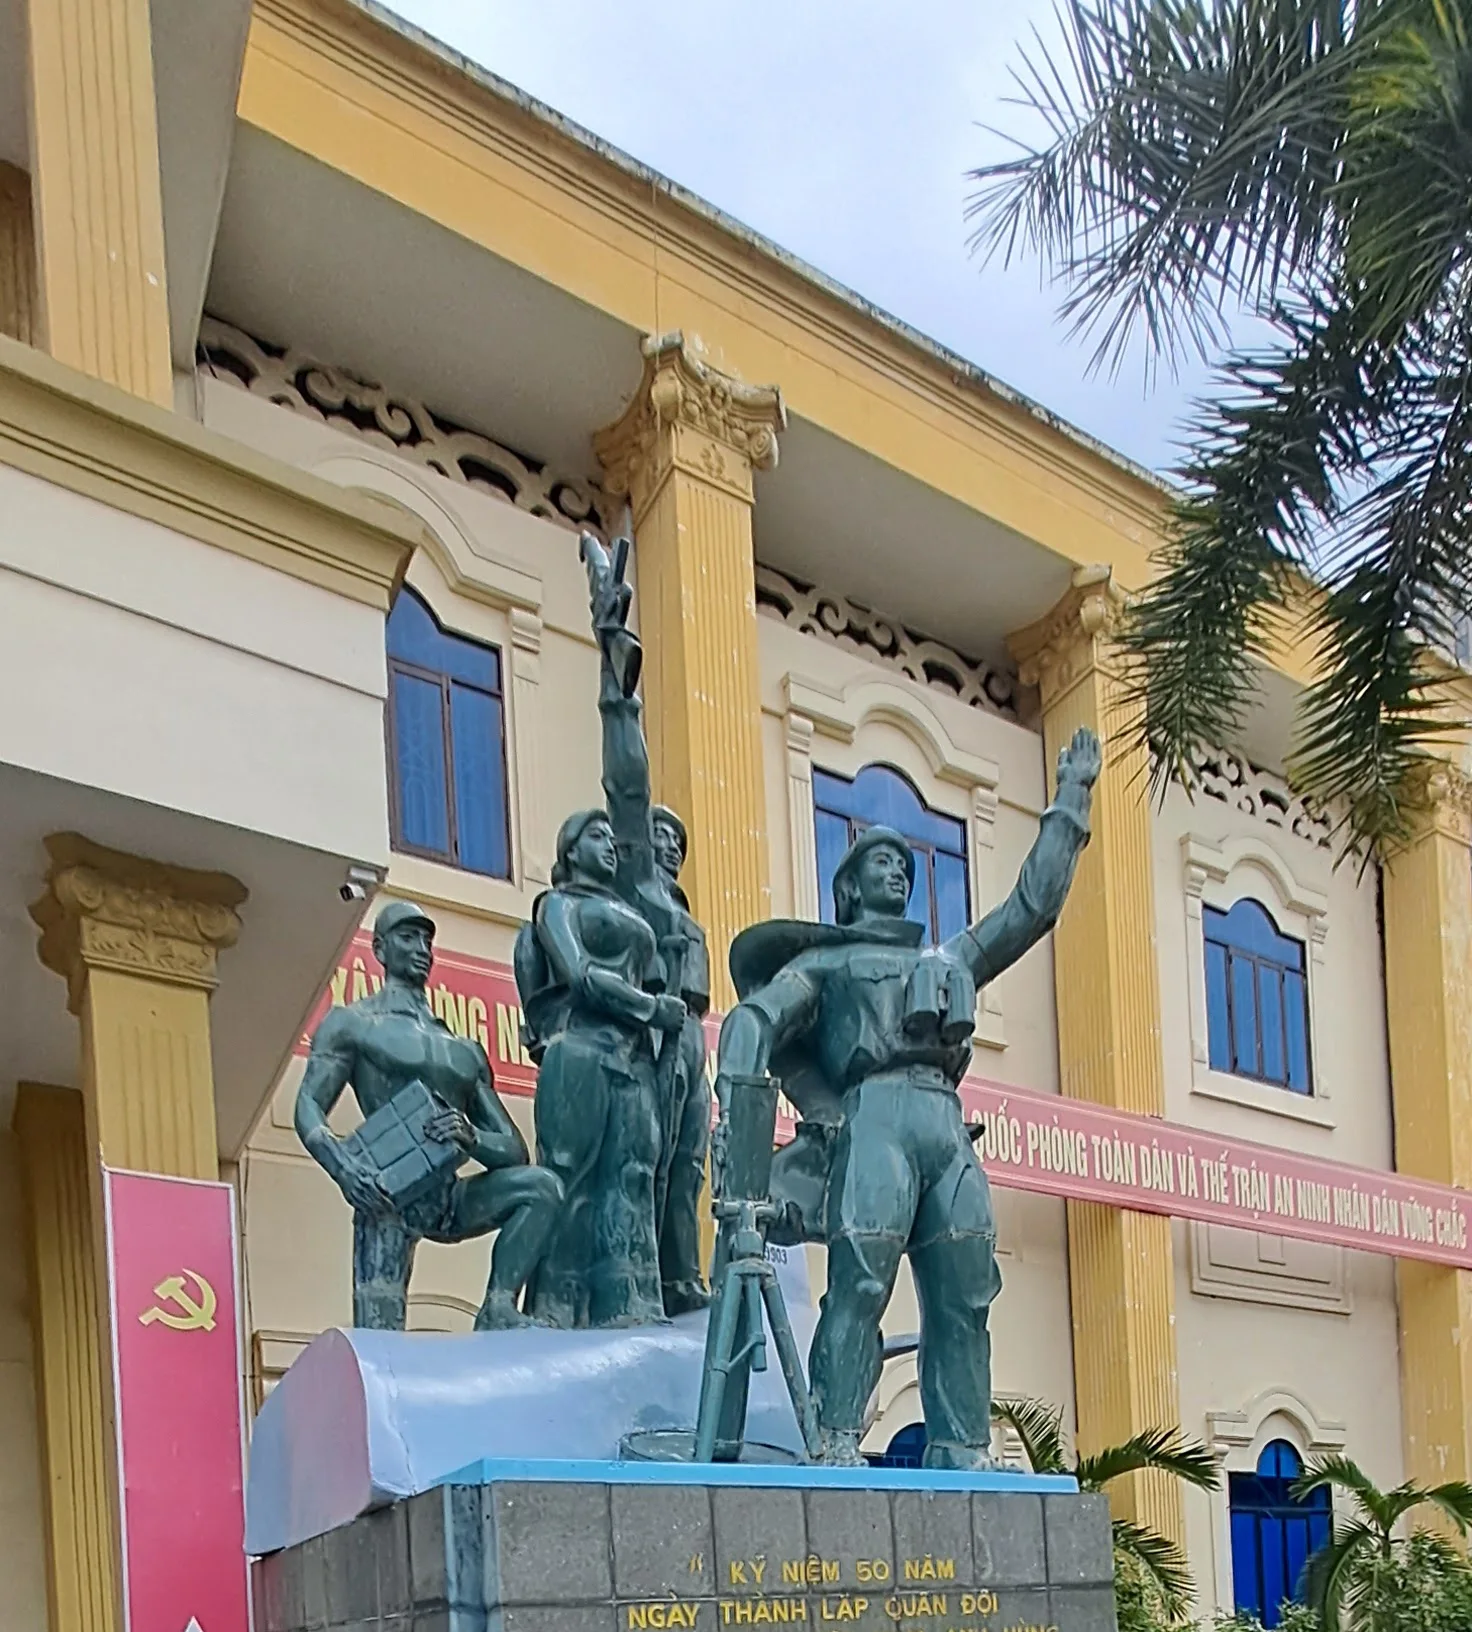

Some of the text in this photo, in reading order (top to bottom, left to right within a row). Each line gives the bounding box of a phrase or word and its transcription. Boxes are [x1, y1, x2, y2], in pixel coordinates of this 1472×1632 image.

[970, 1099, 1022, 1165] QUỐC
[1026, 1115, 1088, 1178] PHÒNG
[1091, 1130, 1137, 1186] TOÀN
[1139, 1138, 1175, 1193] DÂN
[1176, 1146, 1199, 1198] VÀ
[1200, 1150, 1230, 1205] THẾ
[1231, 1160, 1270, 1220] TRẬN
[1274, 1173, 1294, 1217] AN
[1296, 1178, 1331, 1224] NINH
[1333, 1182, 1371, 1232] NHÂN
[1373, 1189, 1400, 1237] DÂN
[782, 1553, 841, 1585] NIỆM
[856, 1558, 889, 1582] 50
[904, 1553, 955, 1581] NĂM
[719, 1590, 807, 1625] THÀNH
[885, 1591, 948, 1622] QUÂN
[960, 1588, 999, 1619] ĐỘI
